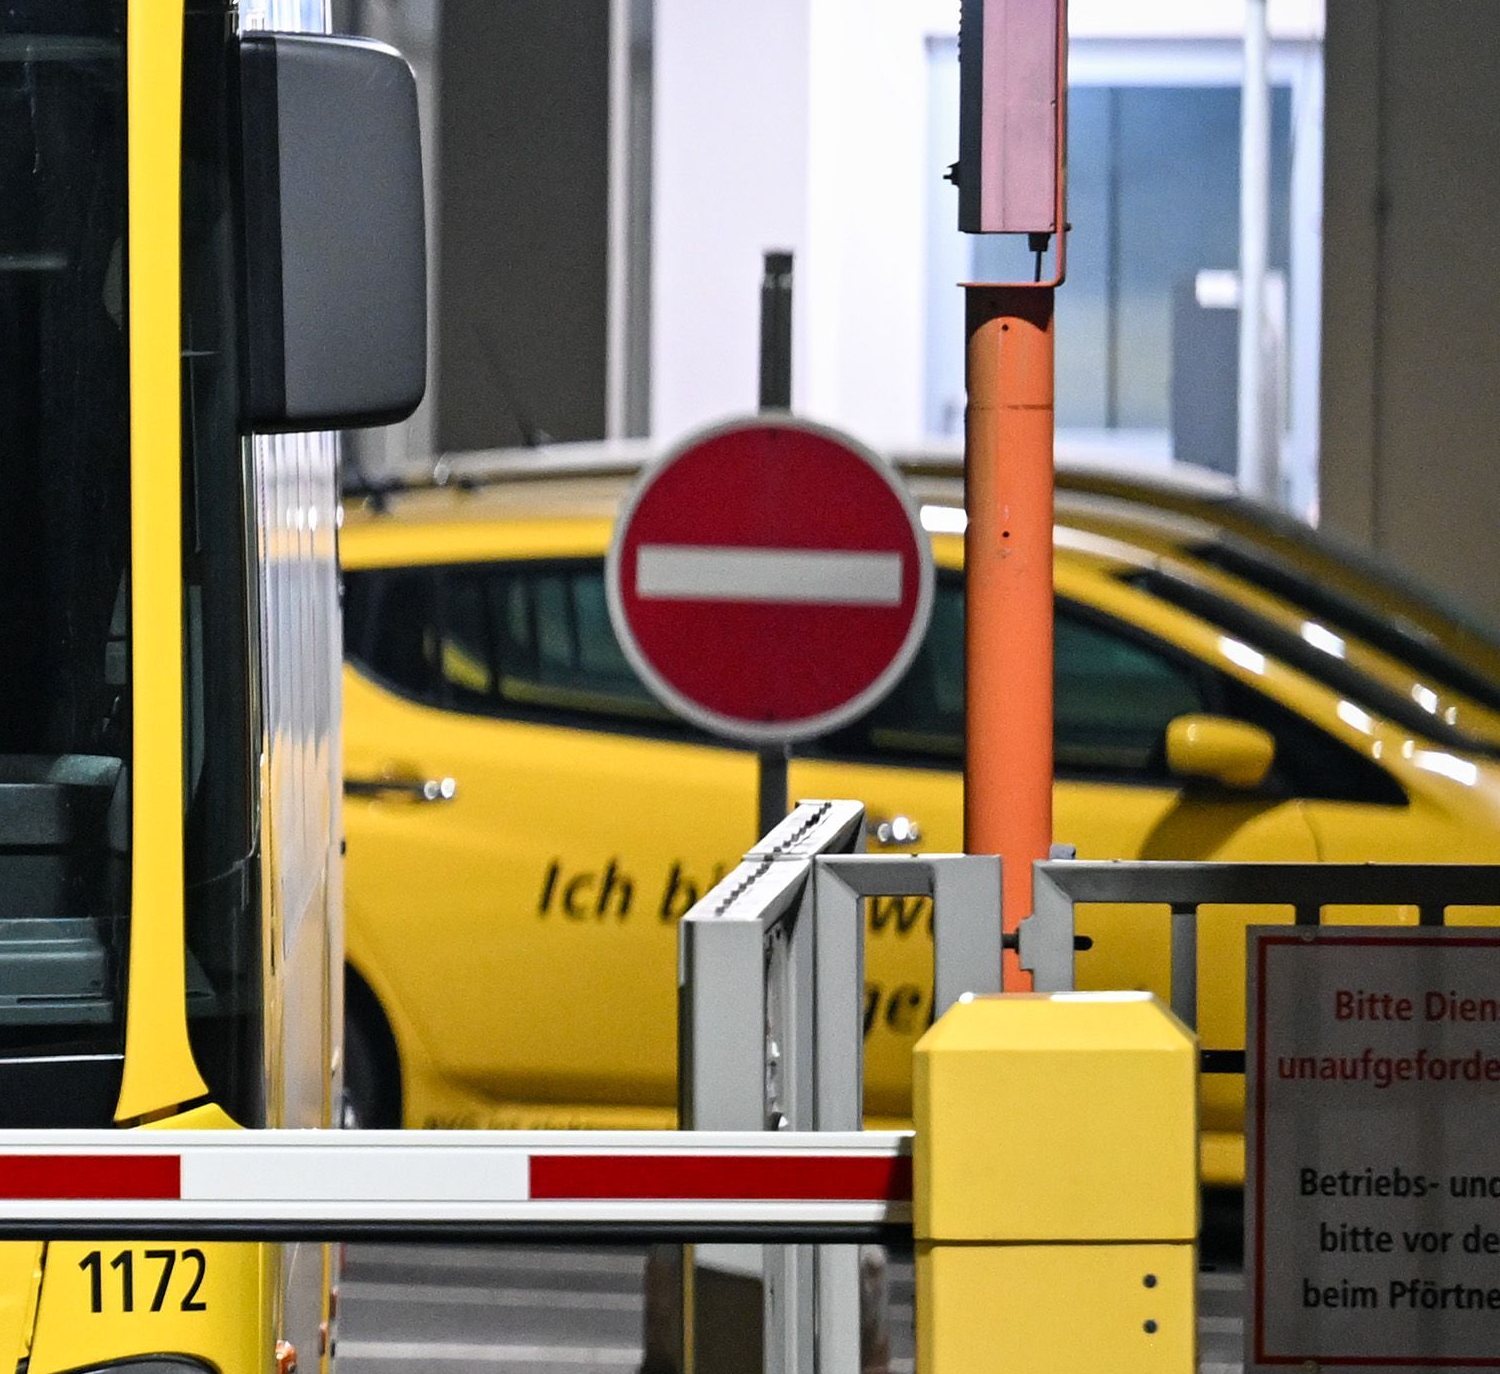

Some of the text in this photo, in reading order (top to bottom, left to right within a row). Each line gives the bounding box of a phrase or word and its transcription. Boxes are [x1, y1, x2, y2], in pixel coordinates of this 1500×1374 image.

[538, 857, 635, 920] Ich
[1335, 989, 1500, 1022] Bitte Dien
[1277, 1047, 1500, 1089] unaufgeforde
[1299, 1167, 1440, 1197] Betriebs-
[1319, 1222, 1500, 1253] bitte vor de
[78, 1248, 207, 1313] 1172
[1302, 1278, 1500, 1310] beim Pförtne
